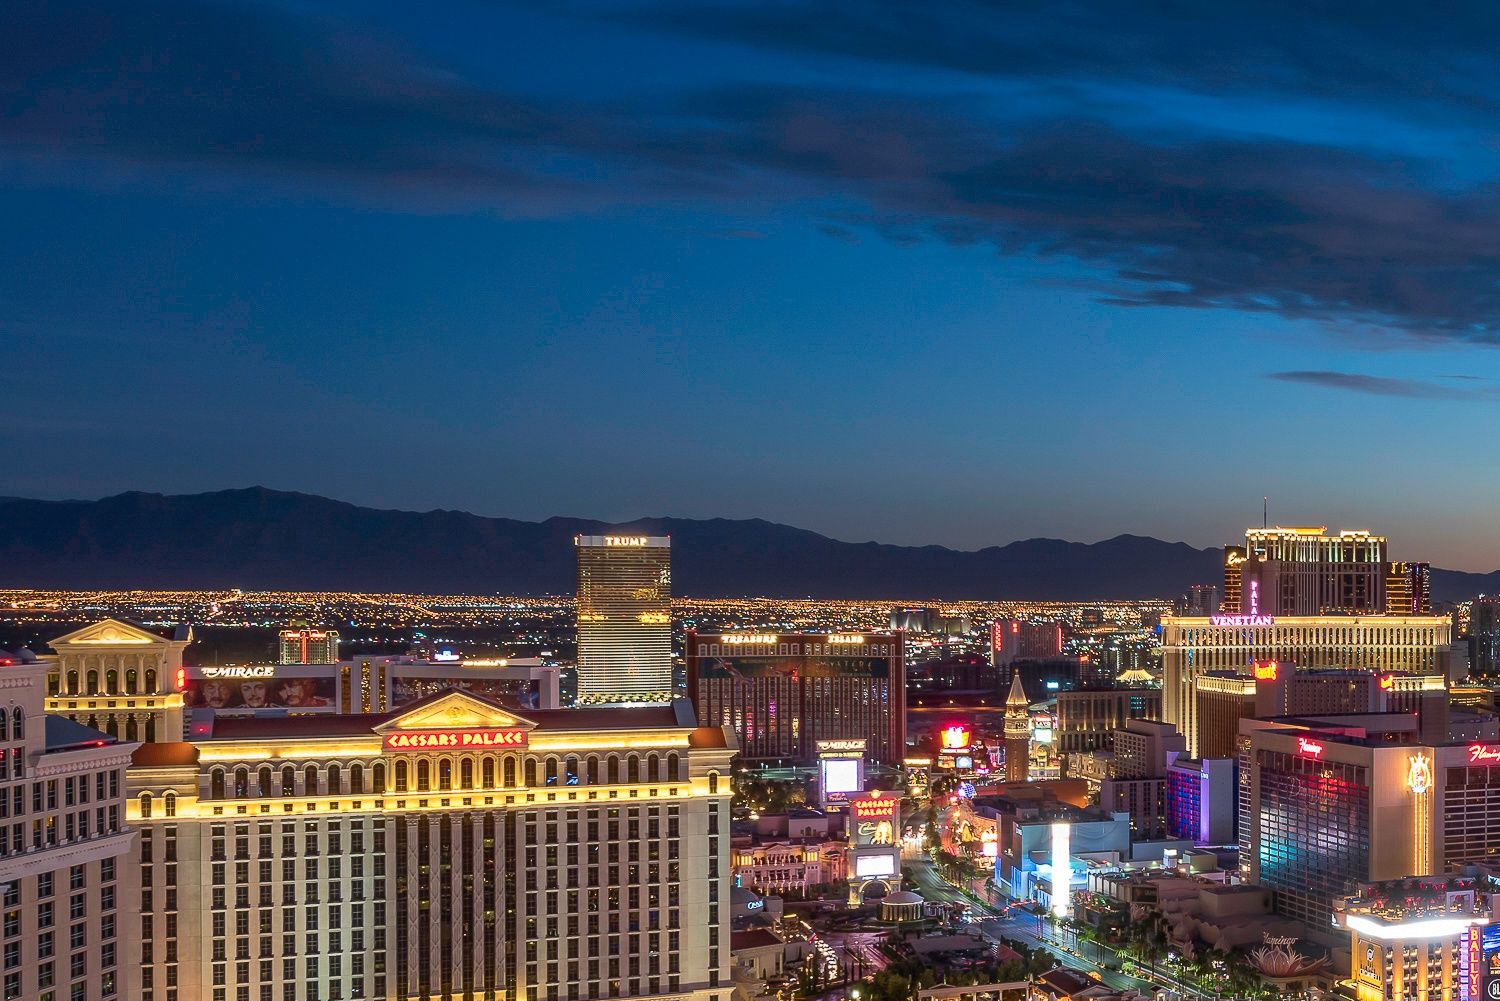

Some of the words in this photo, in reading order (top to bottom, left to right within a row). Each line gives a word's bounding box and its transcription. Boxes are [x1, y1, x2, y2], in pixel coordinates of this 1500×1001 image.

[605, 536, 647, 546] TRUMP
[1212, 615, 1272, 626] VENETIAN
[721, 635, 777, 644] TREASURE
[210, 666, 275, 678] MIRAGE
[388, 733, 458, 747] CAESARS
[462, 731, 522, 745] PALACE
[825, 740, 865, 750] MIRAGE
[855, 800, 895, 808] CAESARS
[857, 808, 893, 816] PALACE
